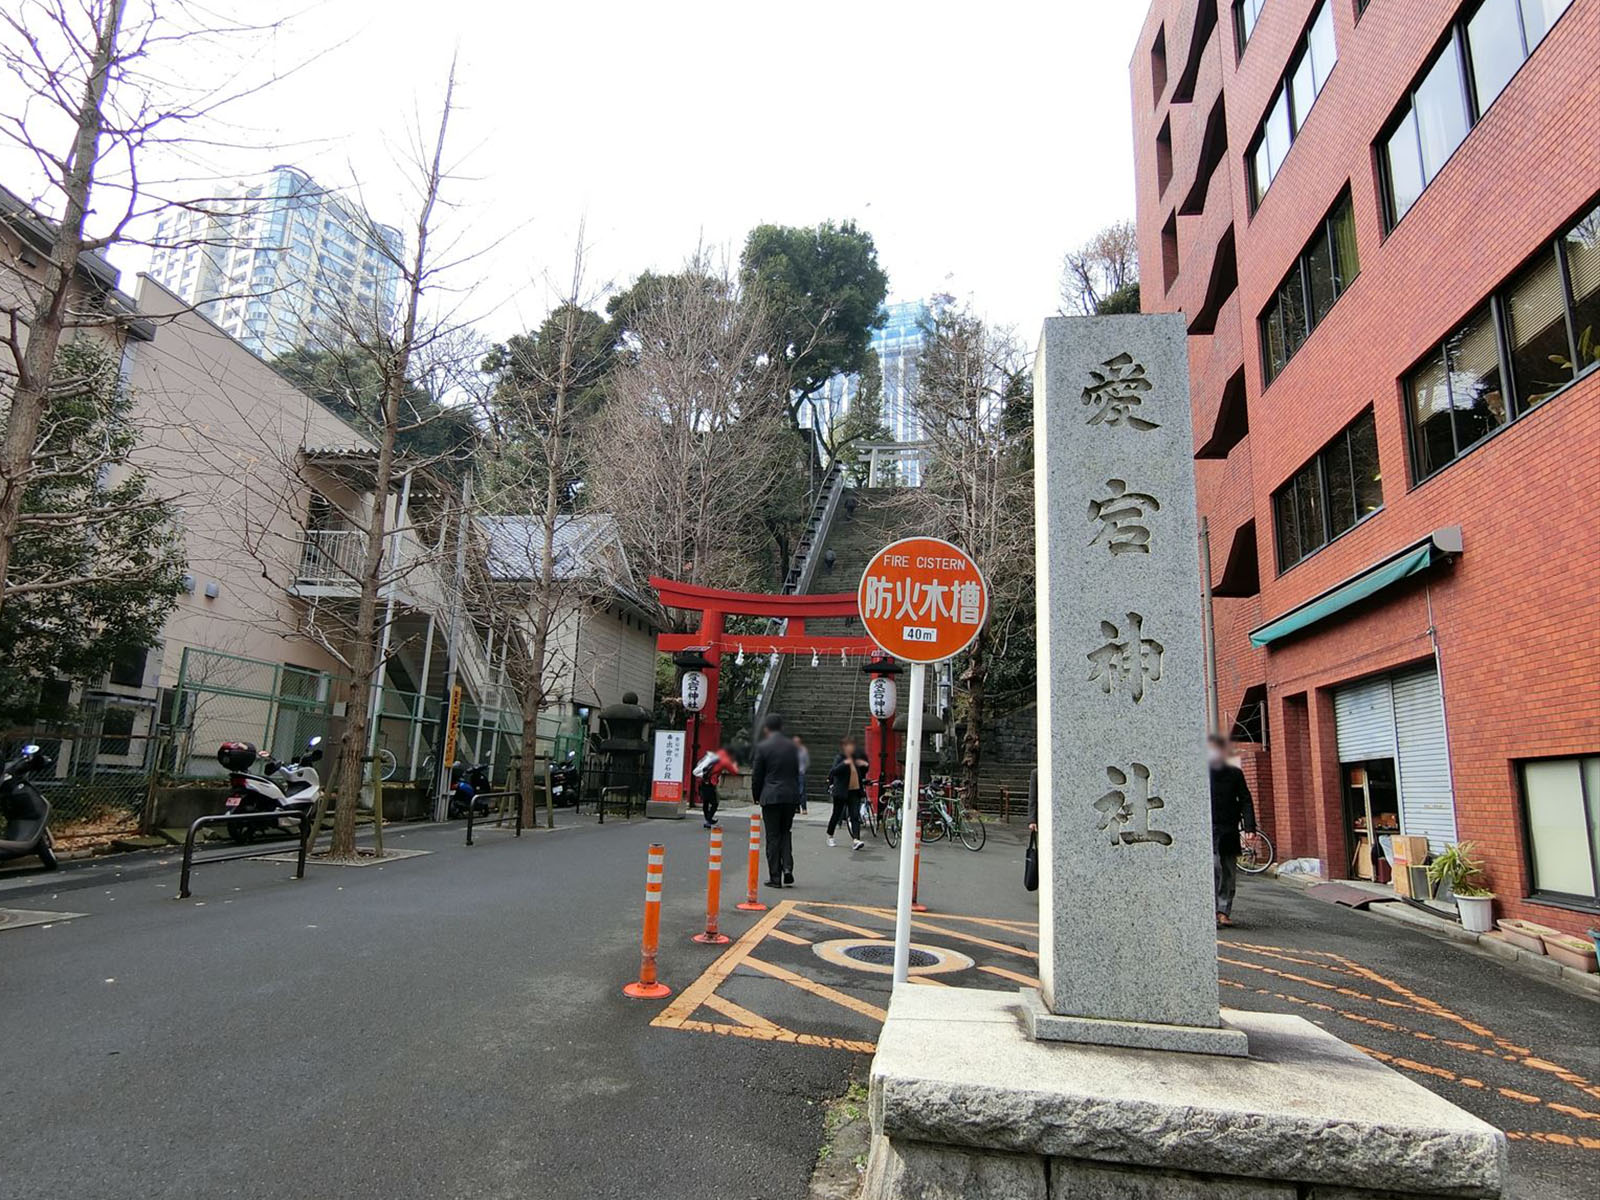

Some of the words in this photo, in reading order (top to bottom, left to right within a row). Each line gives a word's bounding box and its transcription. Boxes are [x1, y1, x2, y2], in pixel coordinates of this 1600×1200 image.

[883, 554, 910, 568] FIRE
[916, 556, 967, 571] CISTERN
[1080, 352, 1173, 847] 愛宕神社
